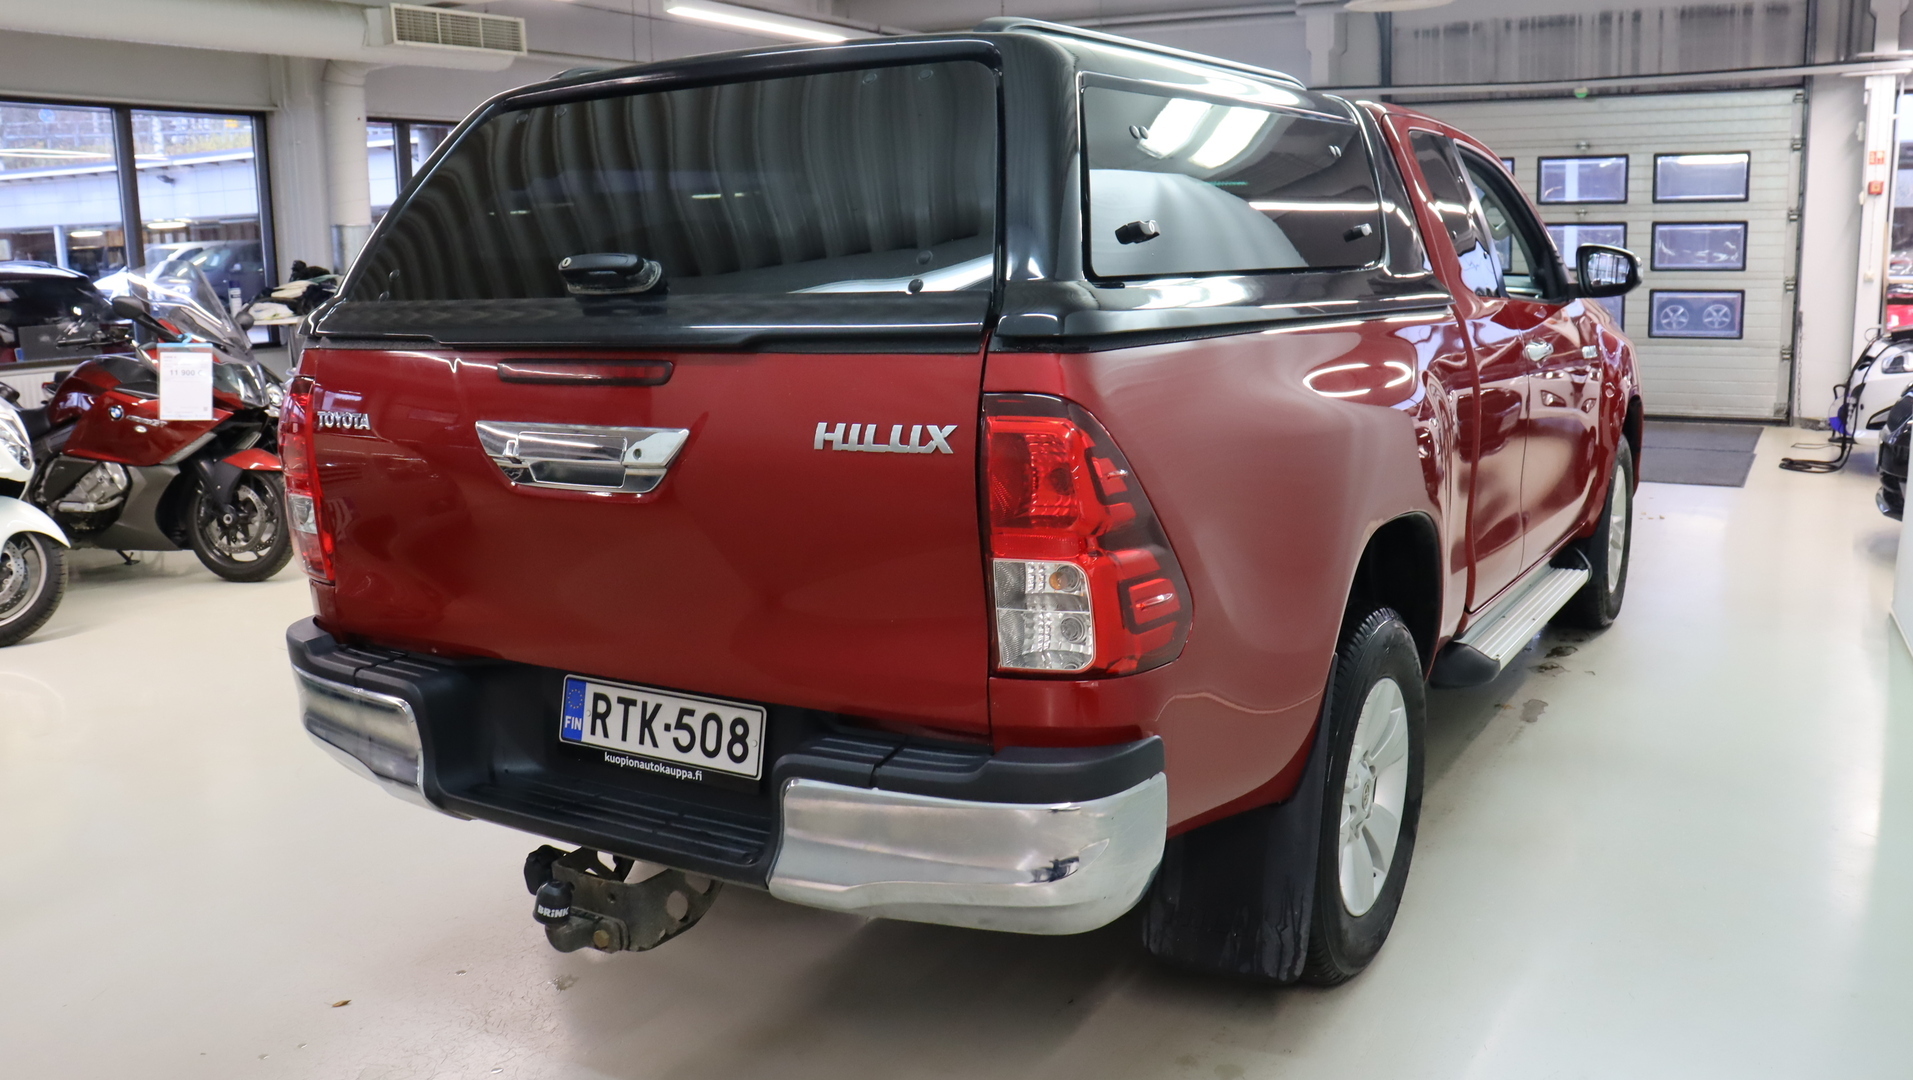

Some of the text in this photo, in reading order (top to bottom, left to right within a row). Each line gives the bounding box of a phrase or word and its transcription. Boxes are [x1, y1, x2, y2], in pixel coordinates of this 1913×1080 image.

[317, 411, 371, 430] TOYOTA
[813, 421, 959, 454] HILUX
[564, 715, 583, 731] FIN
[590, 691, 750, 764] RTK-508
[604, 751, 703, 781] kuopionautokauppa.fi
